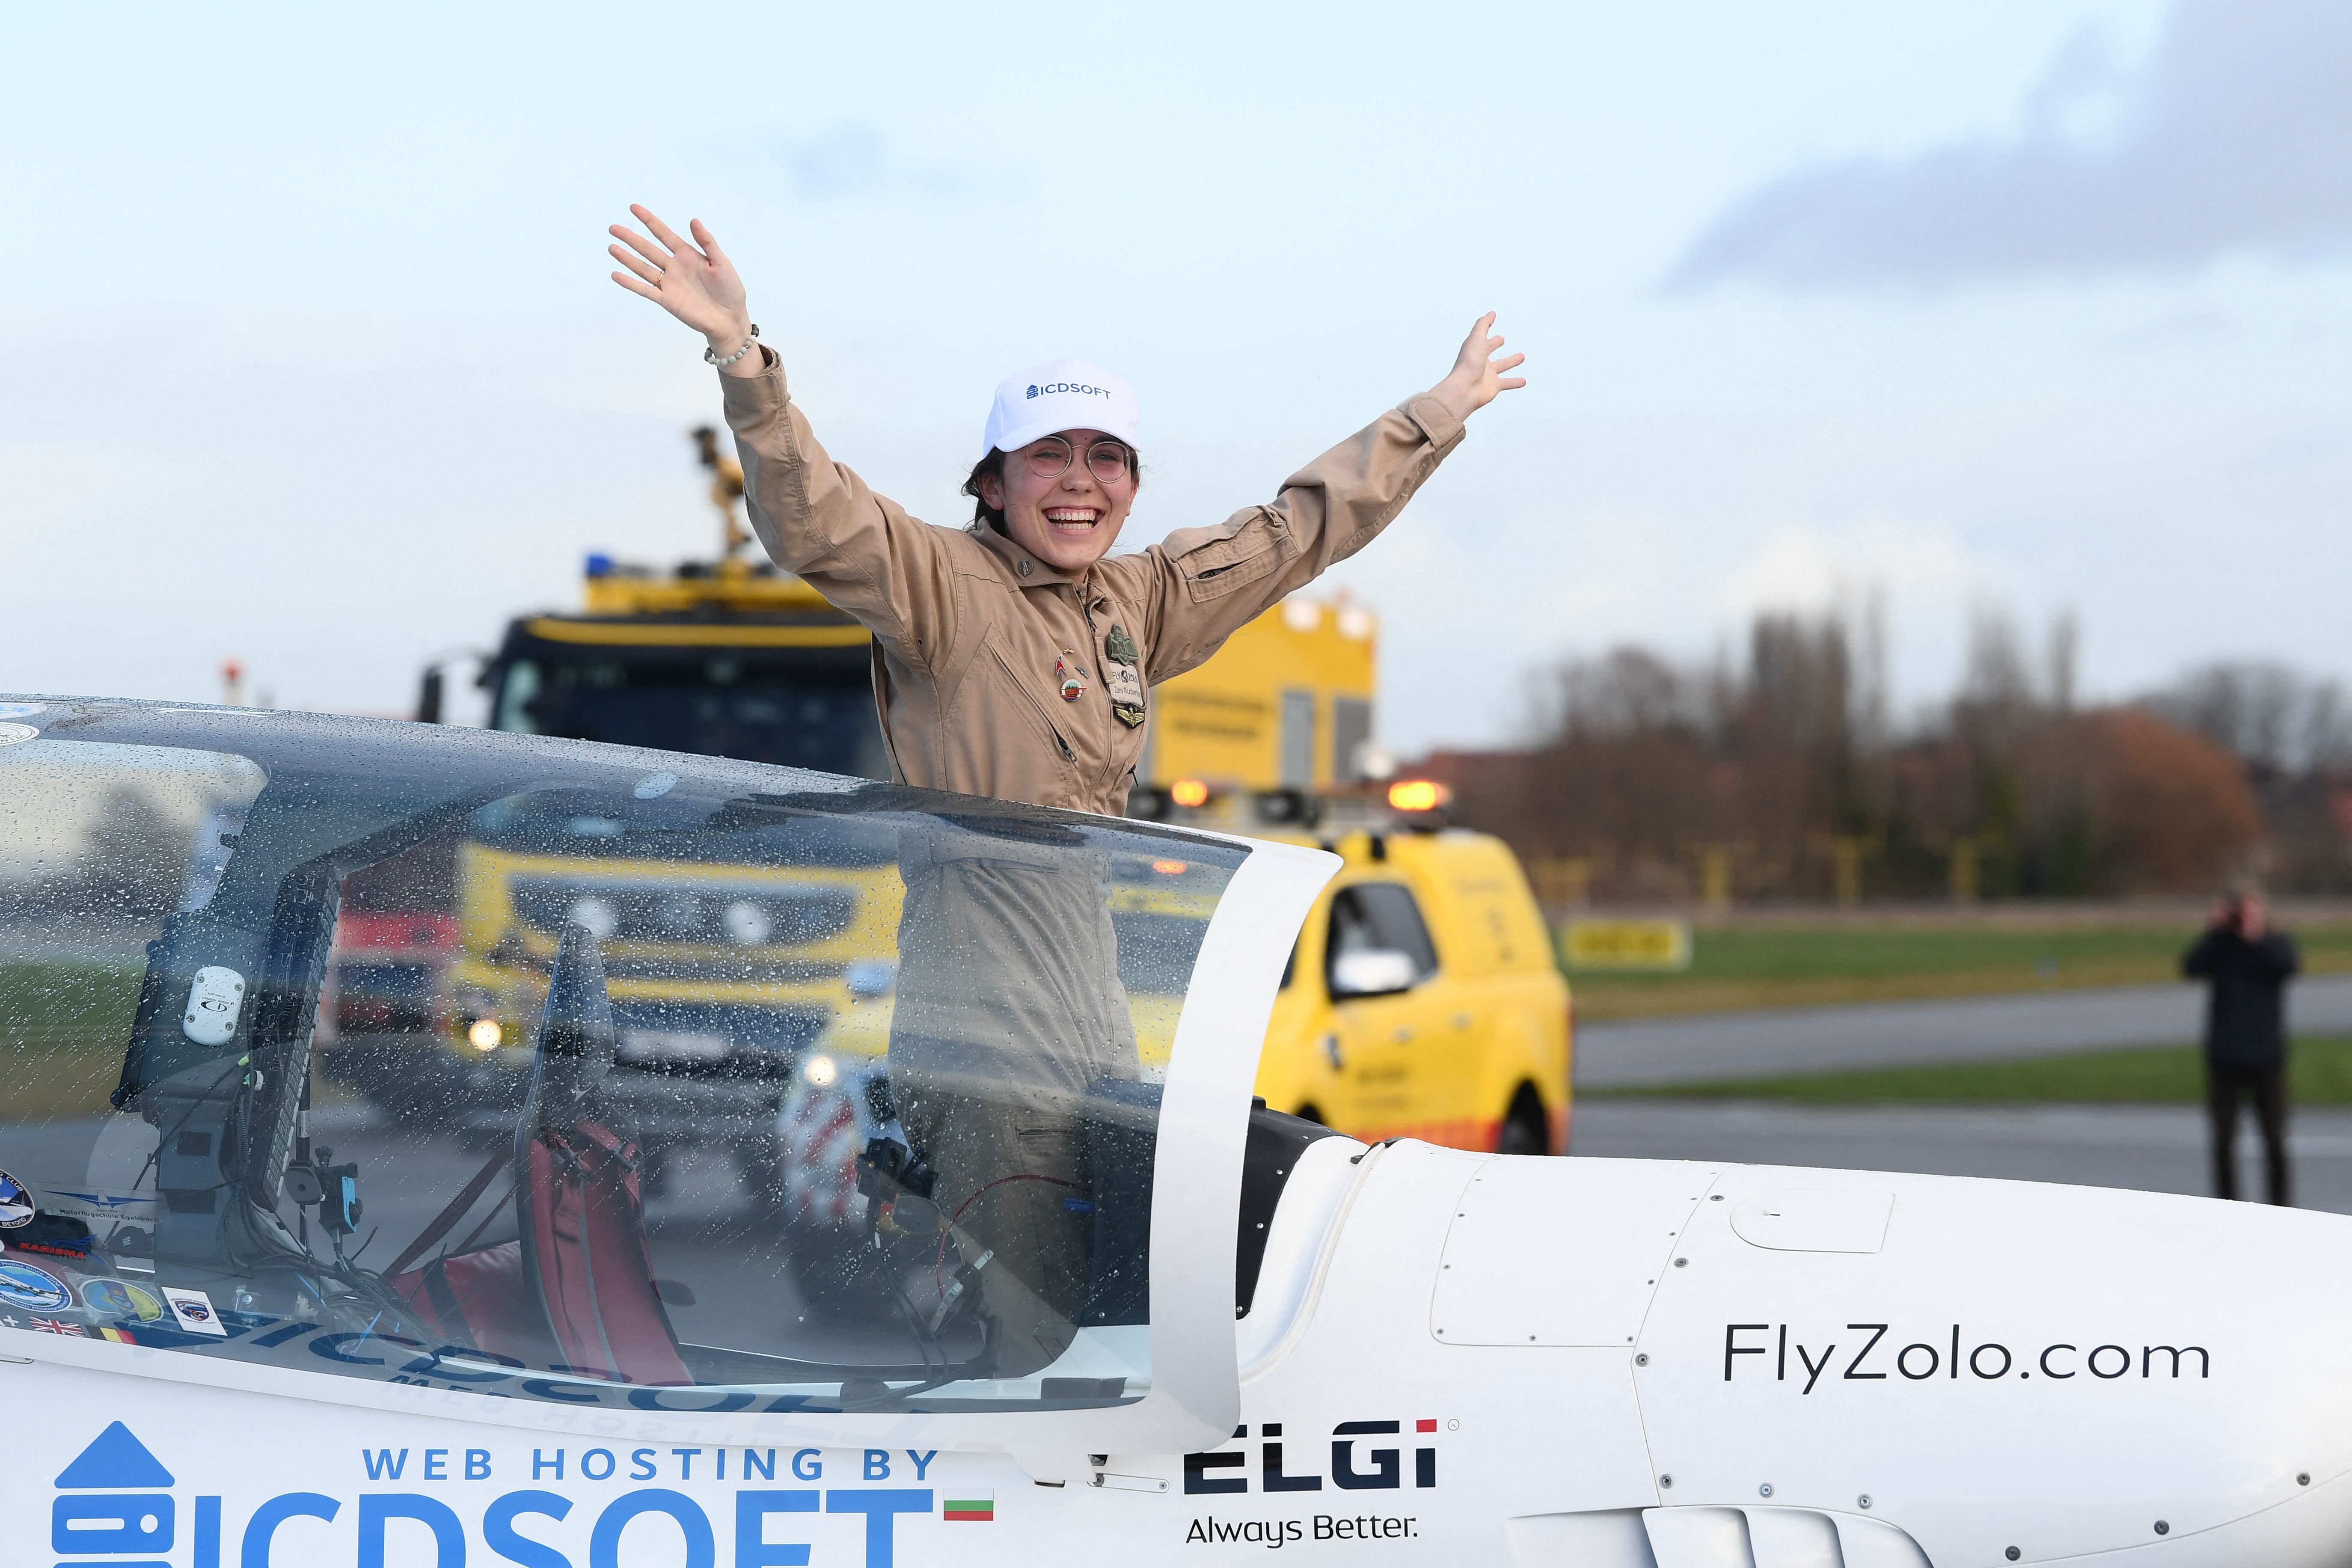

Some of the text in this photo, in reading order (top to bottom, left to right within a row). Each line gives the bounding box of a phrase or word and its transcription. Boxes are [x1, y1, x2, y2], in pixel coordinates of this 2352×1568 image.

[1040, 383, 1111, 400] ICDSOFT
[6, 1176, 24, 1192] CLUB
[2, 1217, 27, 1226] BEYOND
[60, 1209, 119, 1219] Motorflugschule
[20, 1242, 86, 1259] KARISMA
[26, 1266, 44, 1276] Since
[45, 1275, 61, 1287] 2006
[1725, 1324, 2209, 1394] FlyZolo.com
[362, 1449, 938, 1480] WEB HOSTING BY
[194, 1489, 933, 1568] ICDSOFT
[1186, 1515, 1417, 1548] Always Better.
